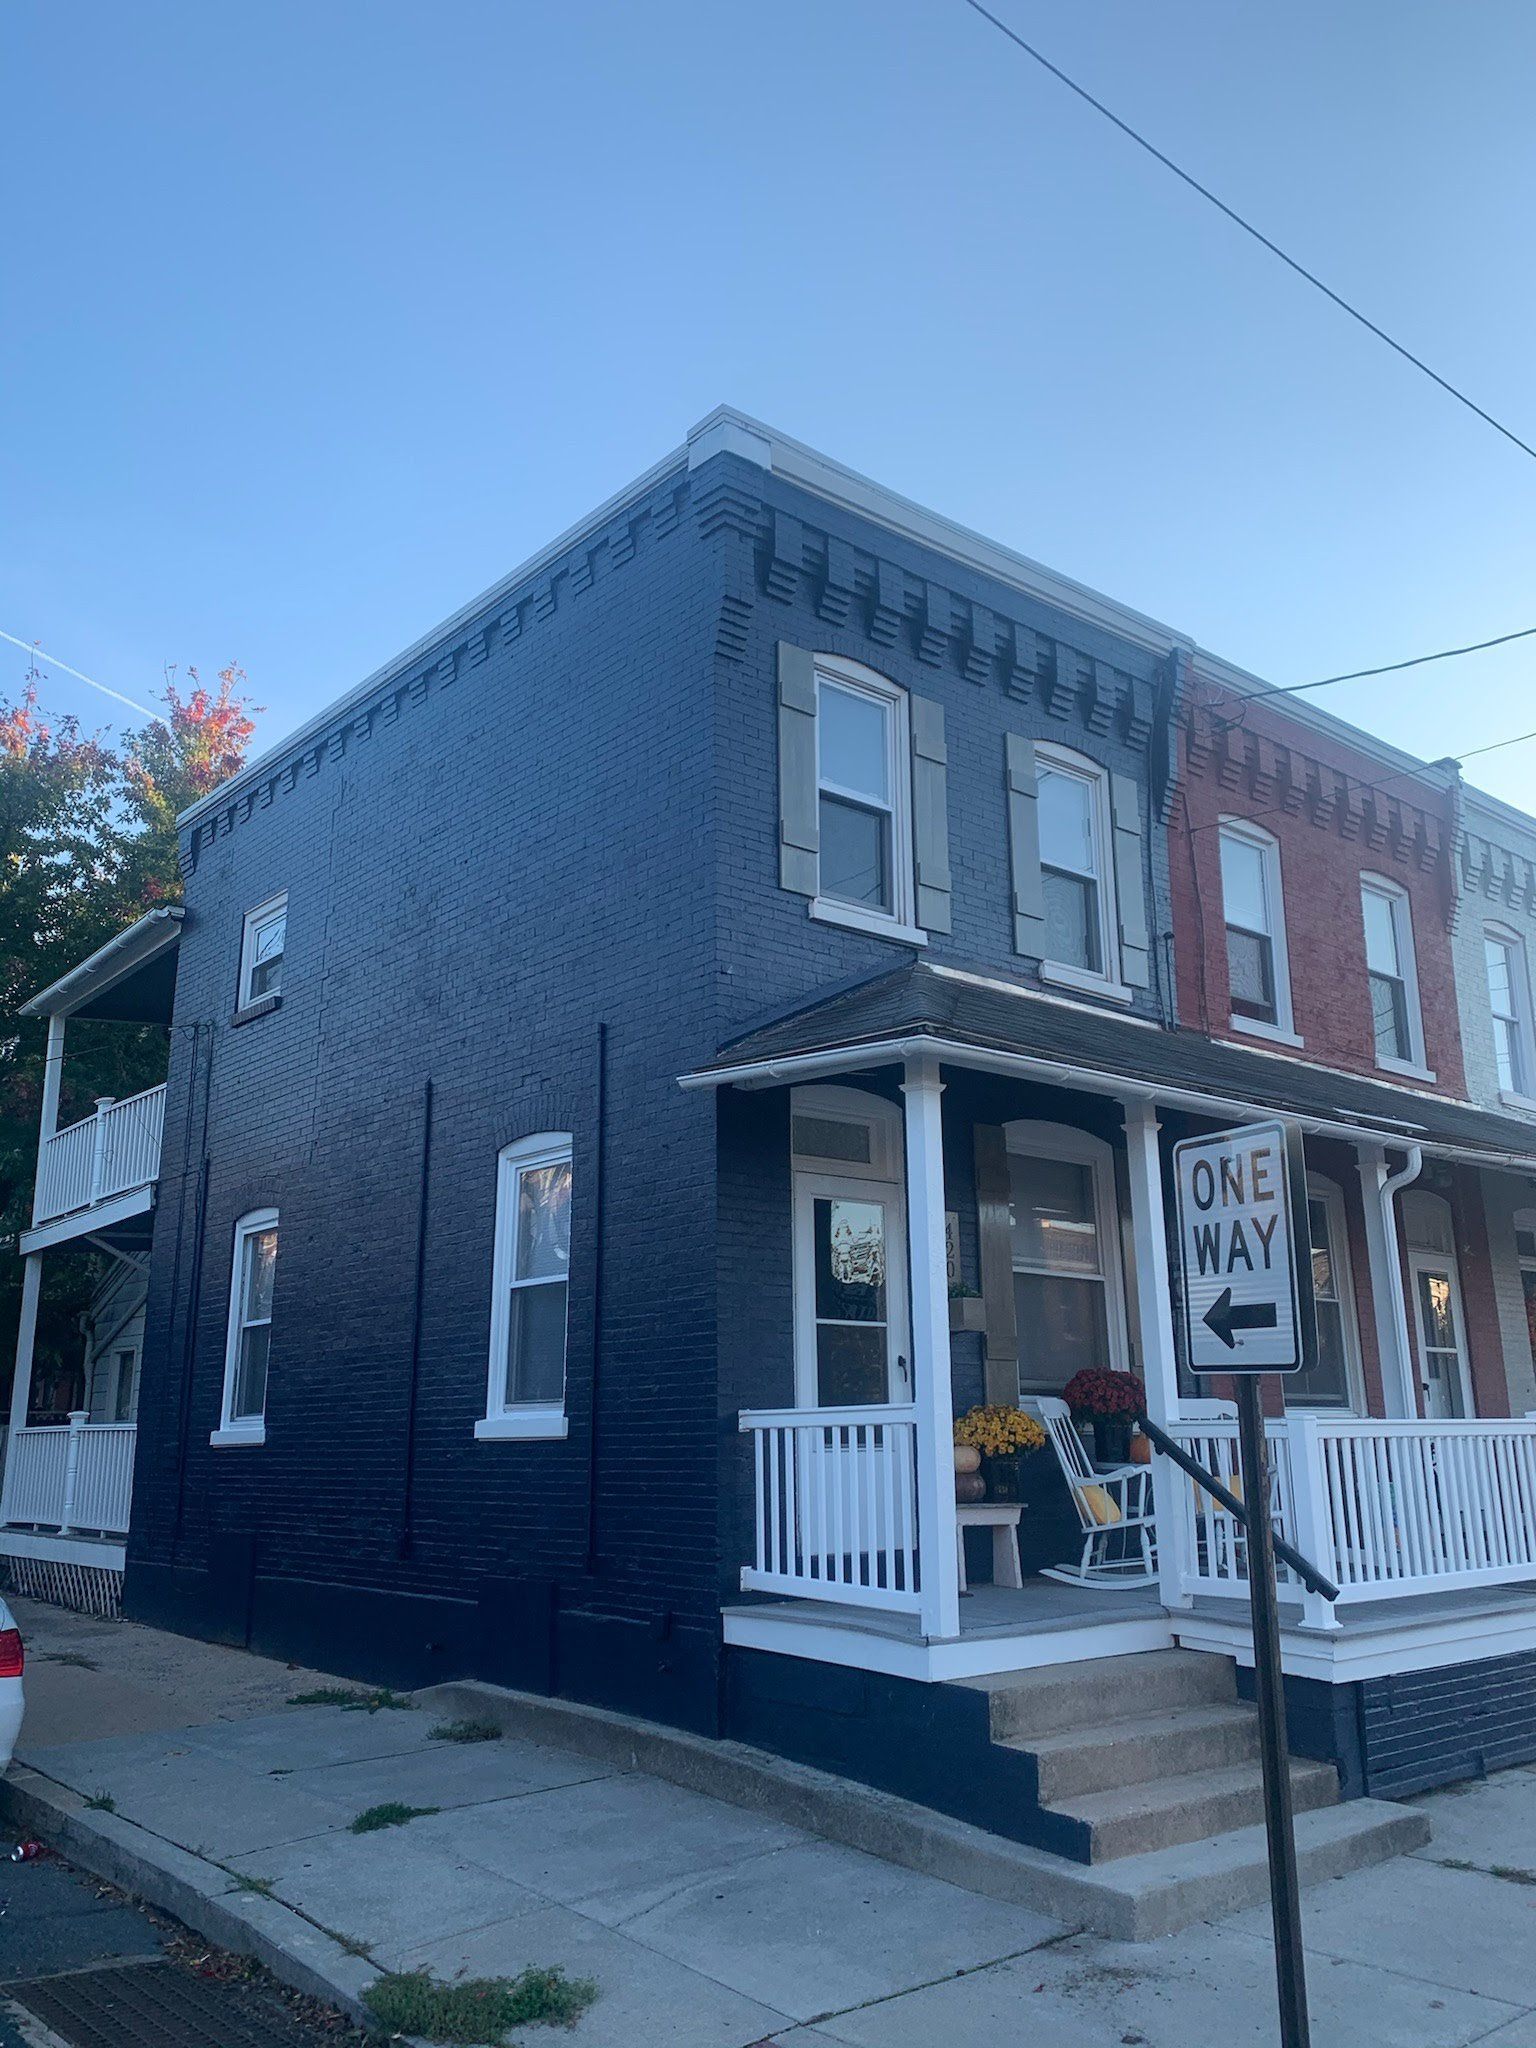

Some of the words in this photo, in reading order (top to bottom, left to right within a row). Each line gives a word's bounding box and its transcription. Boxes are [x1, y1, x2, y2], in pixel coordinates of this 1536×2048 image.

[1192, 1148, 1275, 1211] ONE
[945, 1222, 955, 1278] 420
[1193, 1214, 1278, 1276] WAY
